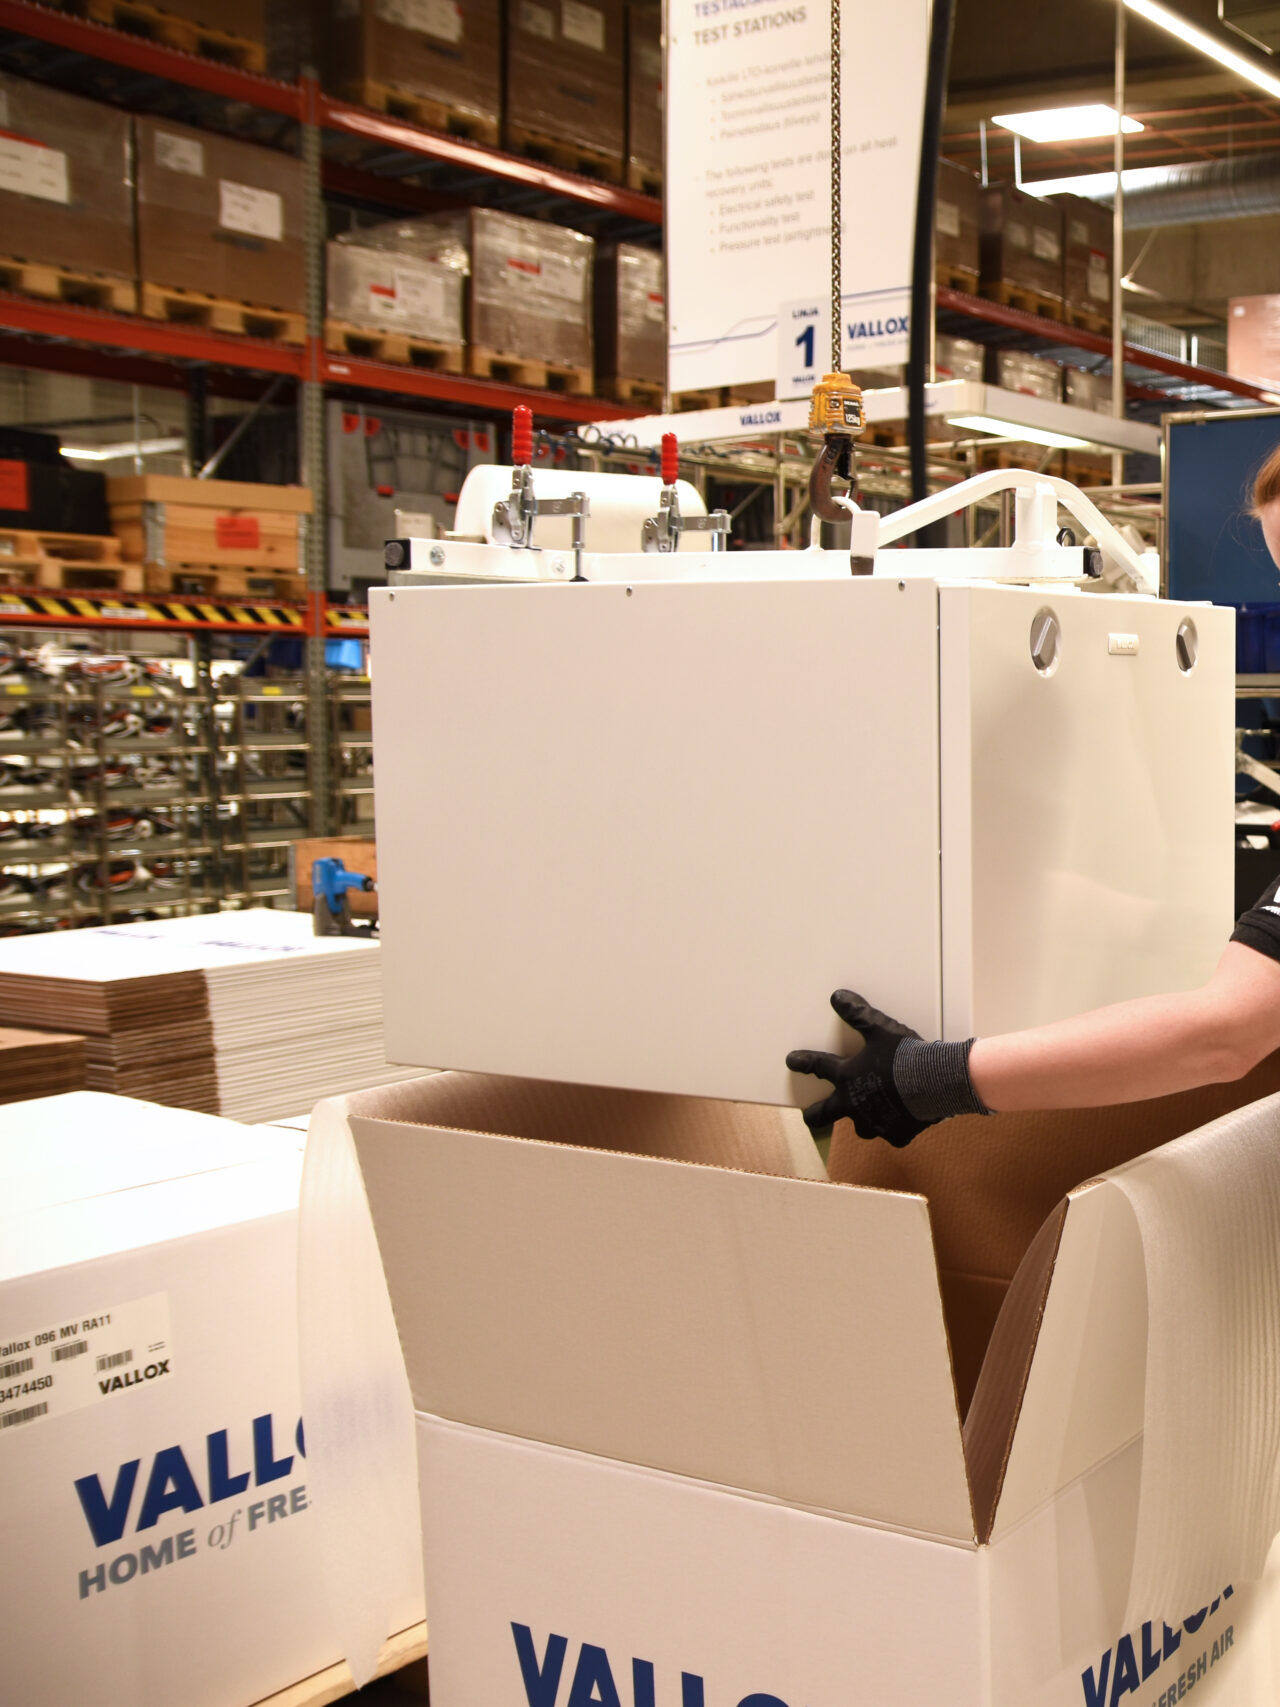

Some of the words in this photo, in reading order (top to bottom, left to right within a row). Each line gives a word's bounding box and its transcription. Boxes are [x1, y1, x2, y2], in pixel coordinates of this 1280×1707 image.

[694, 25, 729, 45] TEST
[733, 6, 807, 37] STATIONS
[726, 162, 768, 178] following
[771, 157, 795, 169] tests
[874, 136, 897, 149] heat
[719, 199, 761, 216] Electrical
[765, 193, 792, 208] safety
[796, 189, 815, 201] test
[719, 214, 778, 233] Functionality
[781, 210, 800, 223] test
[719, 236, 761, 252] Pressure
[763, 232, 781, 244] test
[796, 324, 815, 368] 1
[847, 315, 908, 340] VALLOX
[740, 411, 781, 426] VALLOX
[0, 1340, 31, 1357] allox
[35, 1330, 56, 1346] 096
[59, 1323, 79, 1339] MV
[82, 1313, 111, 1332] RA11
[98, 1359, 171, 1395] VALLOX
[74, 1413, 307, 1548] VALL
[78, 1529, 198, 1600] HOME
[207, 1508, 242, 1549] of
[247, 1485, 311, 1532] FRE
[1081, 1584, 1235, 1707] VALL
[1210, 1624, 1235, 1668] AIR
